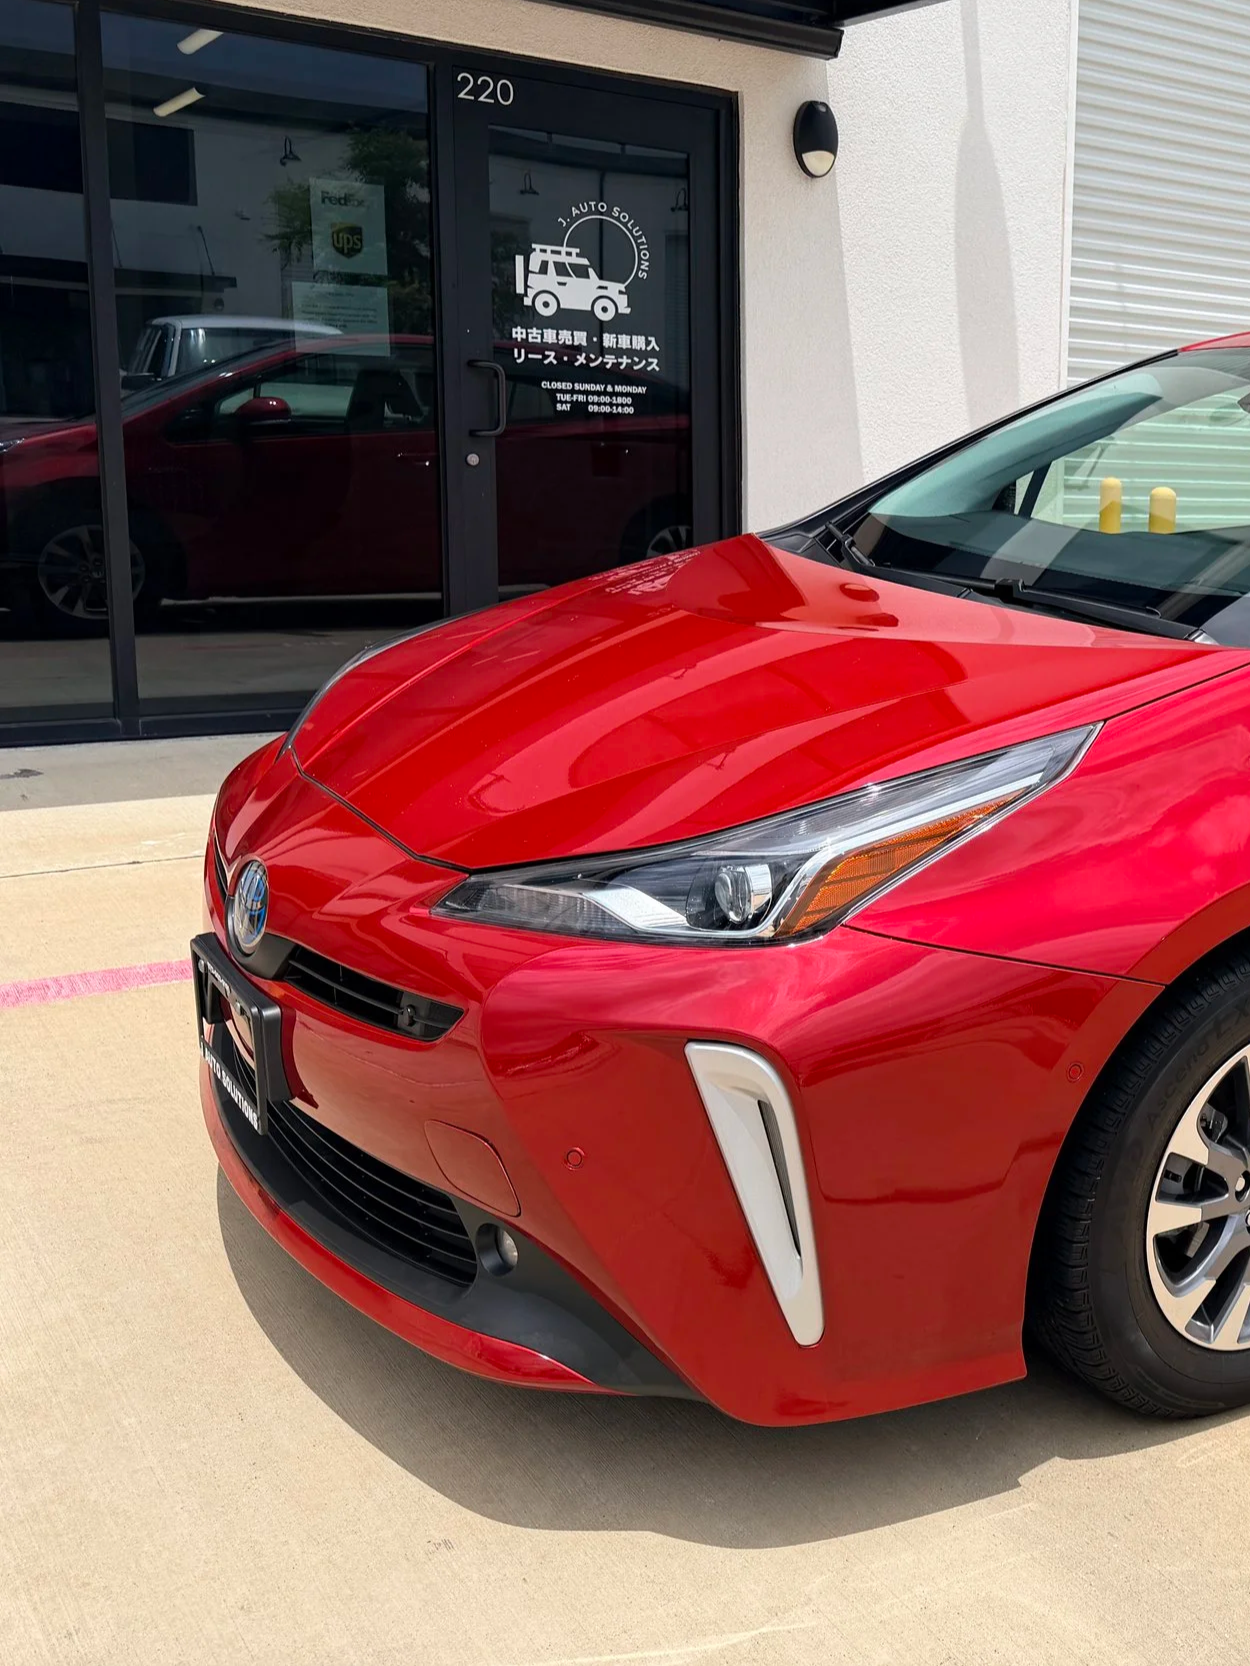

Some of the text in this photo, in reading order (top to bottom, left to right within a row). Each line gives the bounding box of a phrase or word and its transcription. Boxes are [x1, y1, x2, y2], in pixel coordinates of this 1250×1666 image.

[457, 72, 514, 105] 220
[557, 201, 650, 280] J. AUTO SOLUTIONS
[541, 381, 647, 394] CLOSED SUNDAY & MONDAY
[556, 393, 587, 402] TUE-FRI
[588, 404, 634, 414] 09:00-14:00
[204, 1051, 221, 1080] AUTO
[221, 1070, 259, 1129] SOLUTIONS
